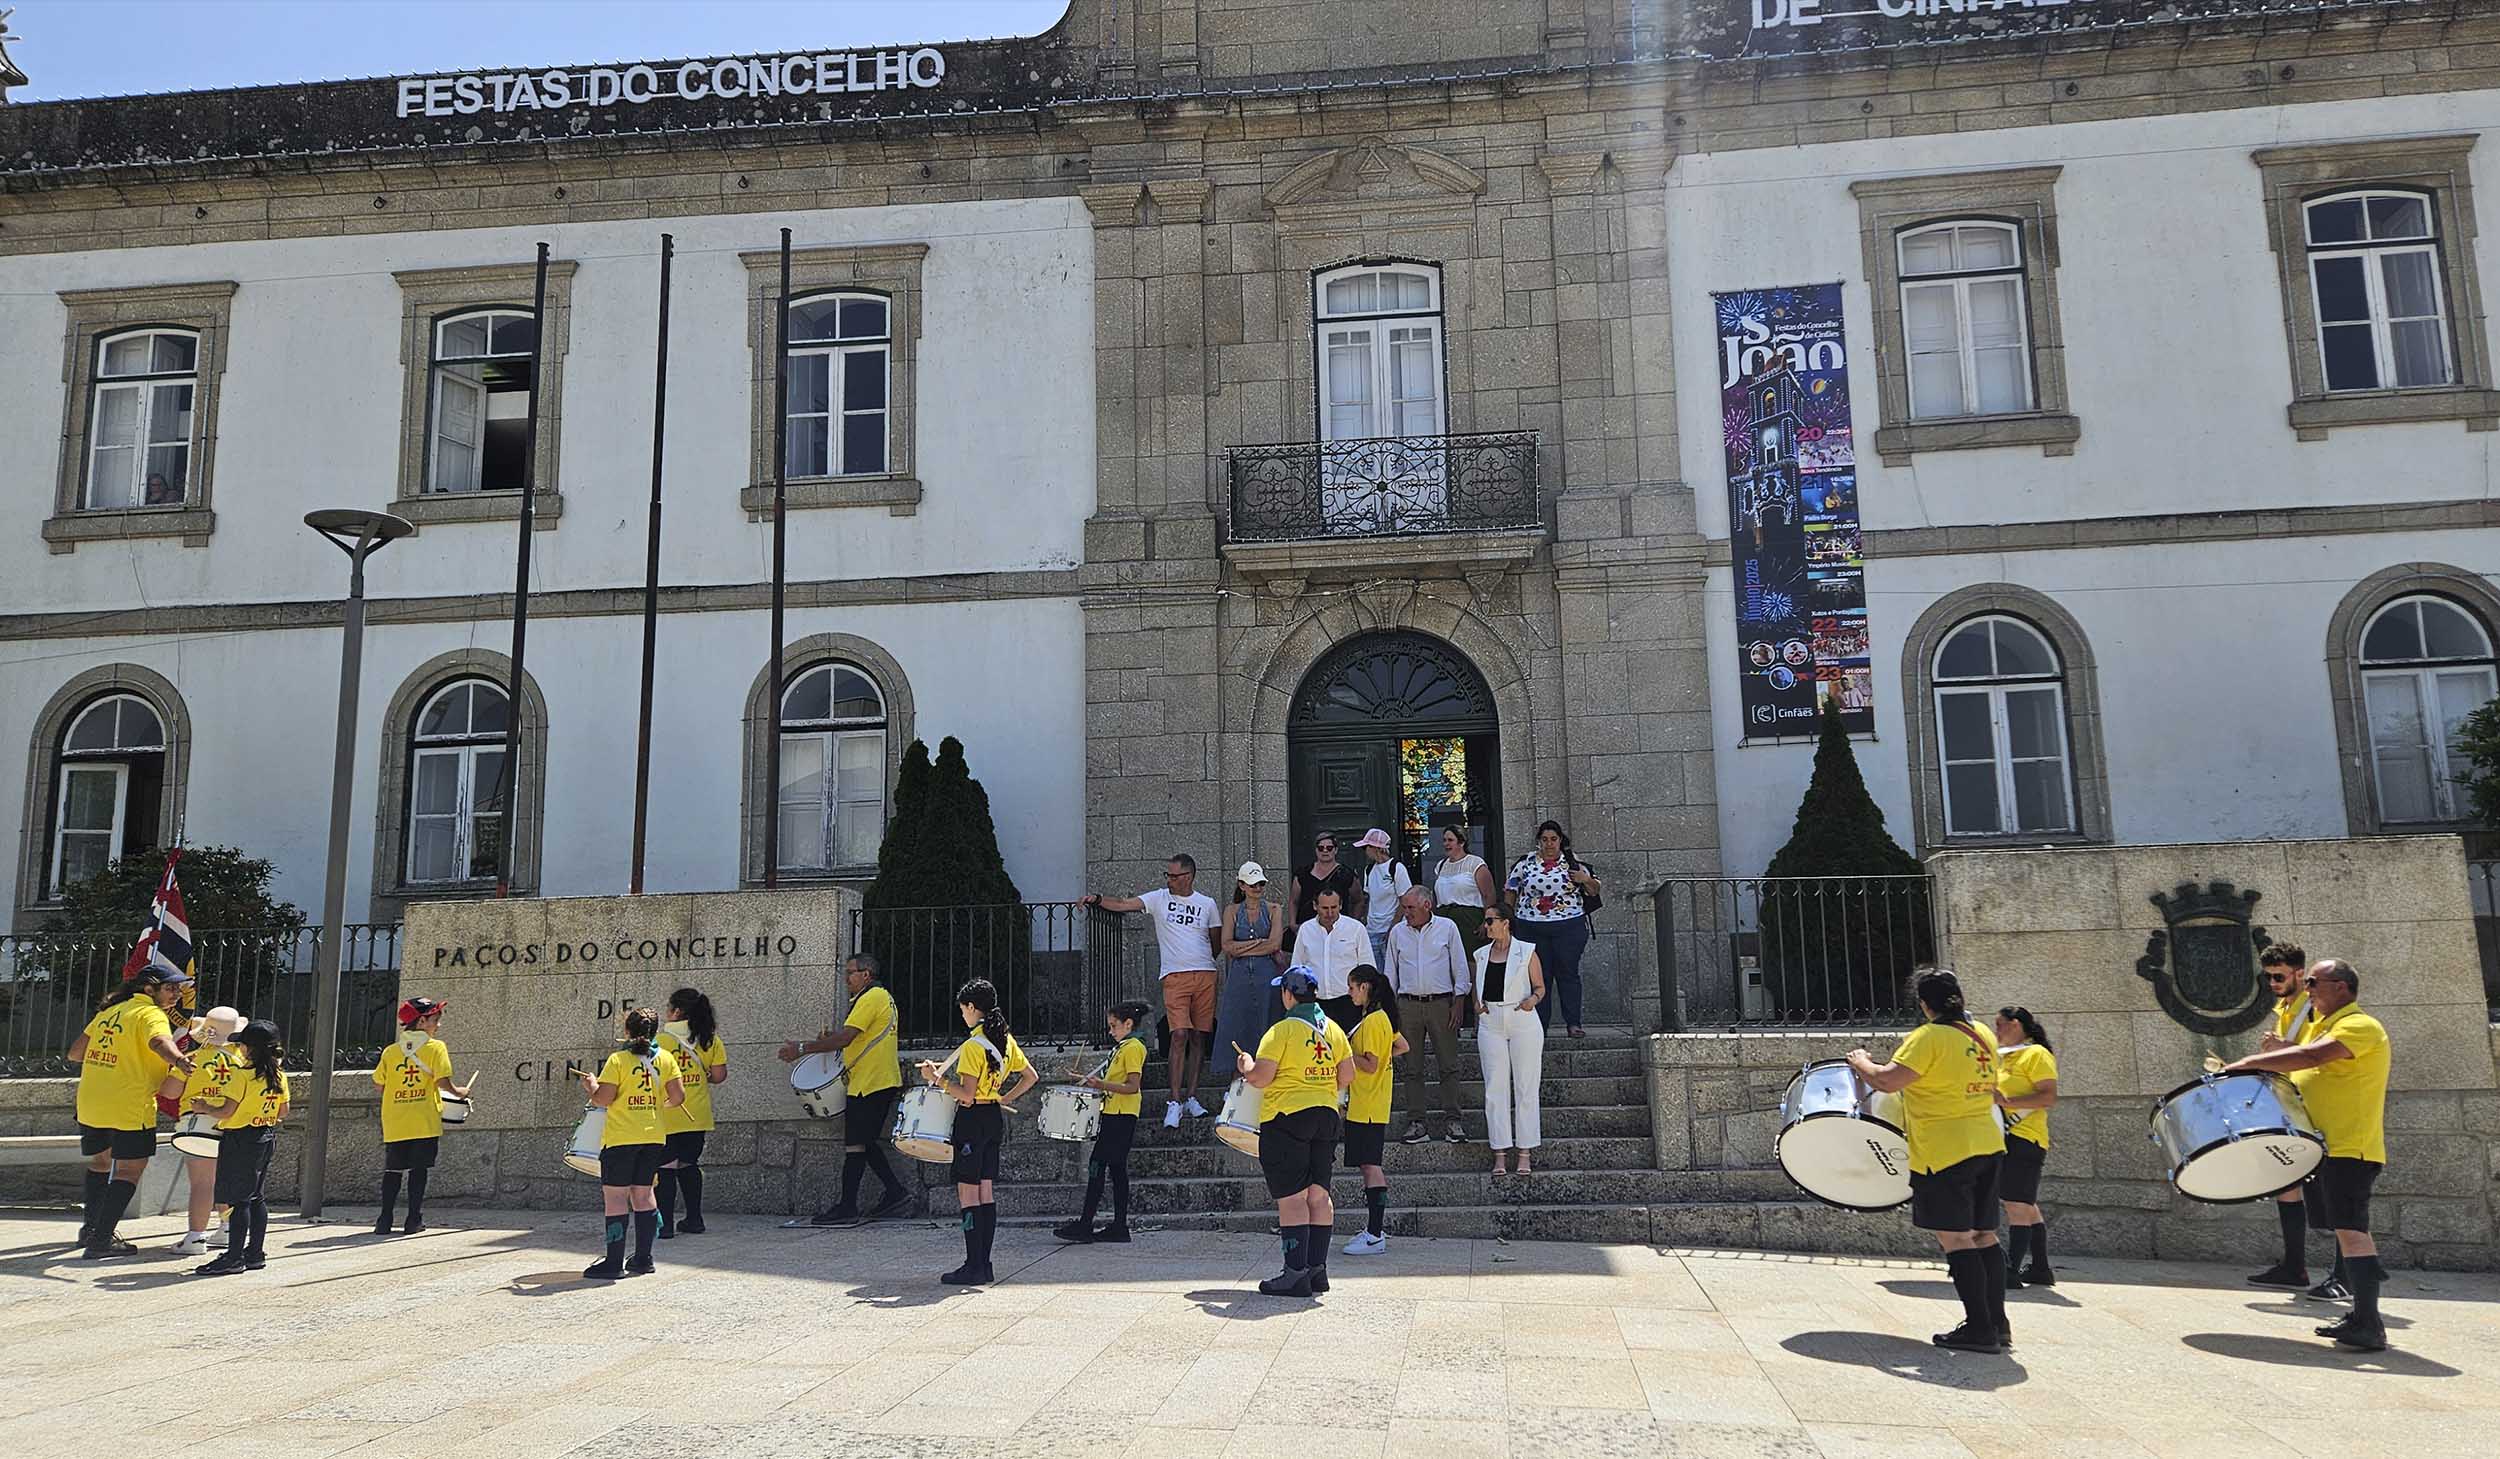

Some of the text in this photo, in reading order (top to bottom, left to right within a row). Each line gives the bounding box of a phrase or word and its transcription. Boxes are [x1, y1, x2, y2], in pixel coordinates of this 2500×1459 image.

[396, 48, 946, 118] FESTAS DO CONCELHO
[1722, 331, 1845, 390] João
[1797, 427, 1823, 441] 20
[1801, 475, 1822, 488] 21
[1811, 617, 1838, 632] 22
[1816, 667, 1840, 680] 23
[1778, 707, 1814, 718] Cinfães
[434, 935, 797, 969] PAÇOS DO CONCELHO
[597, 999, 636, 1020] DE
[202, 1087, 222, 1095] CNE
[628, 1096, 645, 1106] CNE
